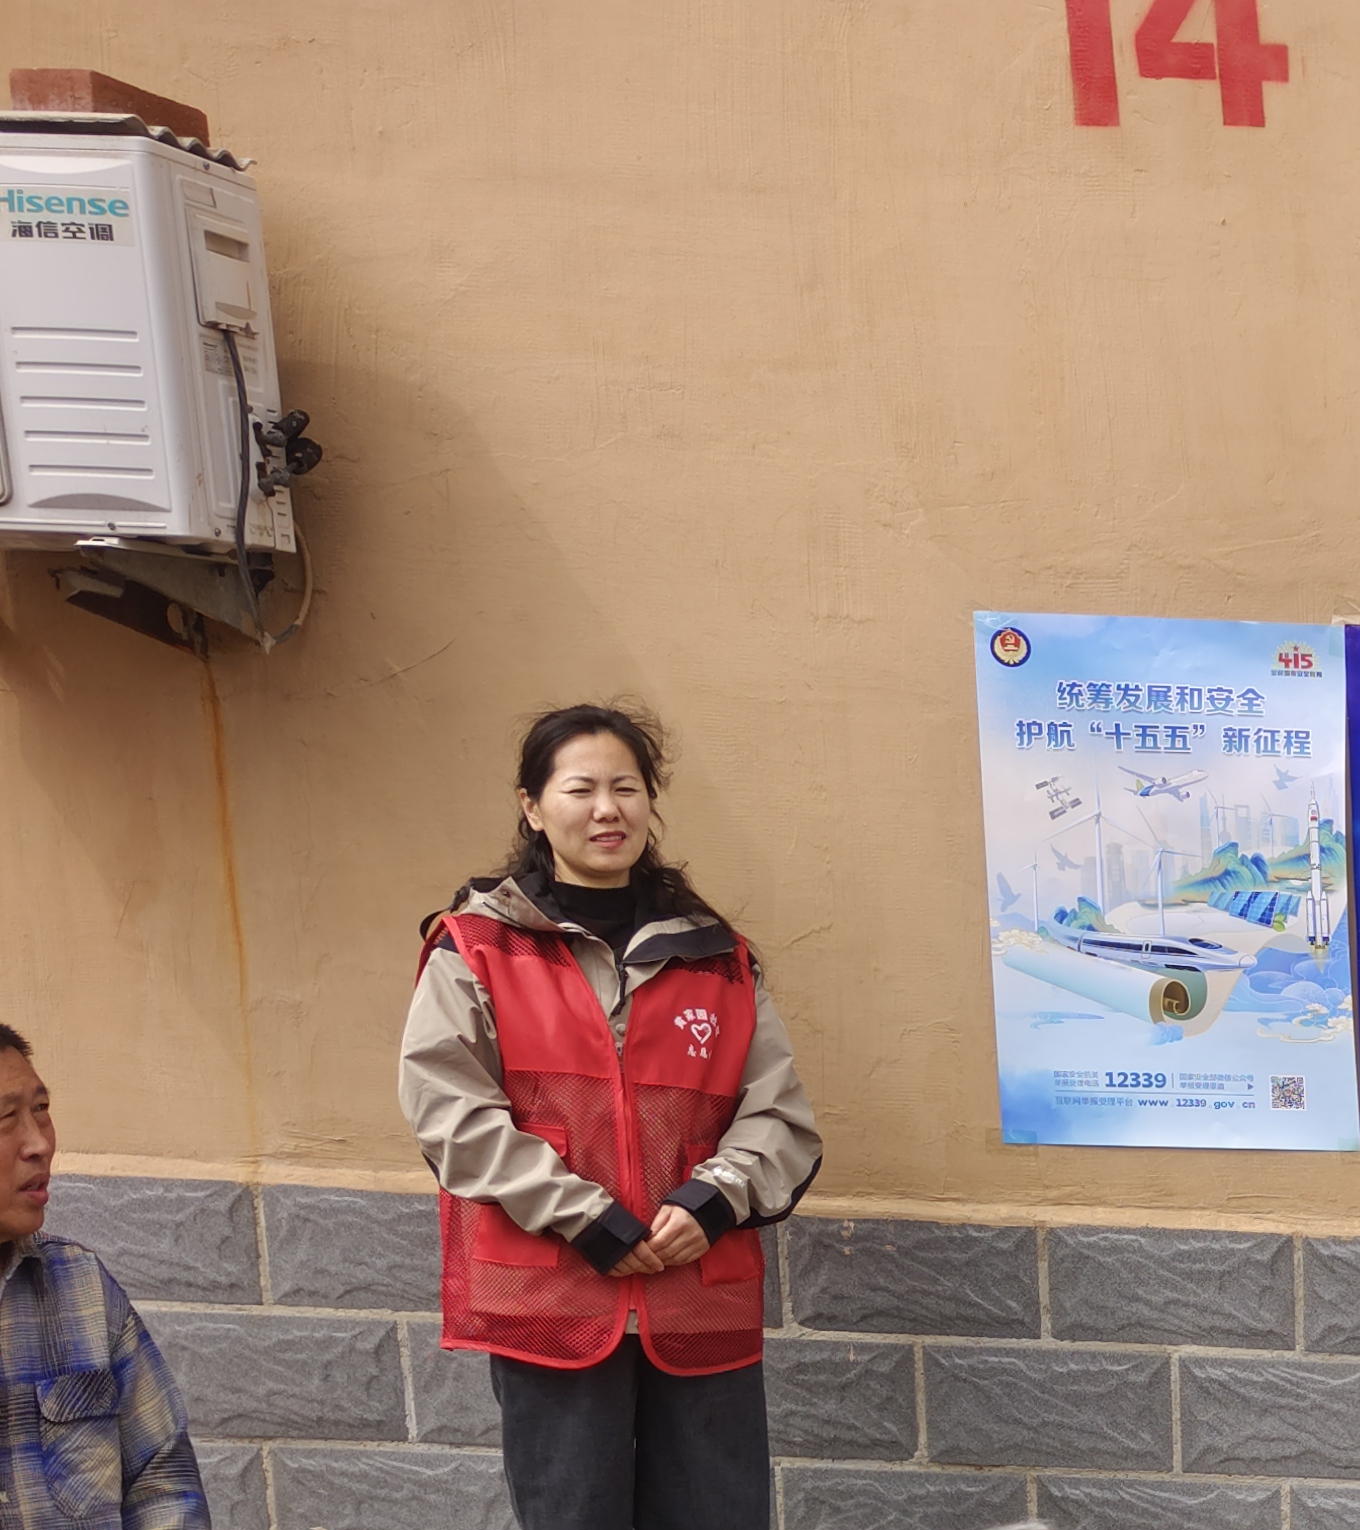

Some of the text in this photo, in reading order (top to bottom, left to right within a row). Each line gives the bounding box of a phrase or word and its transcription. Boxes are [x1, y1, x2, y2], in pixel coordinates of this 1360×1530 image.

[0, 189, 129, 217] Hisense
[11, 220, 114, 241] 海信空调
[1278, 652, 1313, 669] 415
[1056, 680, 1266, 717] 统筹发展和安全
[1015, 720, 1313, 757] 护航“十五五”新征程
[1105, 1071, 1167, 1089] 12339
